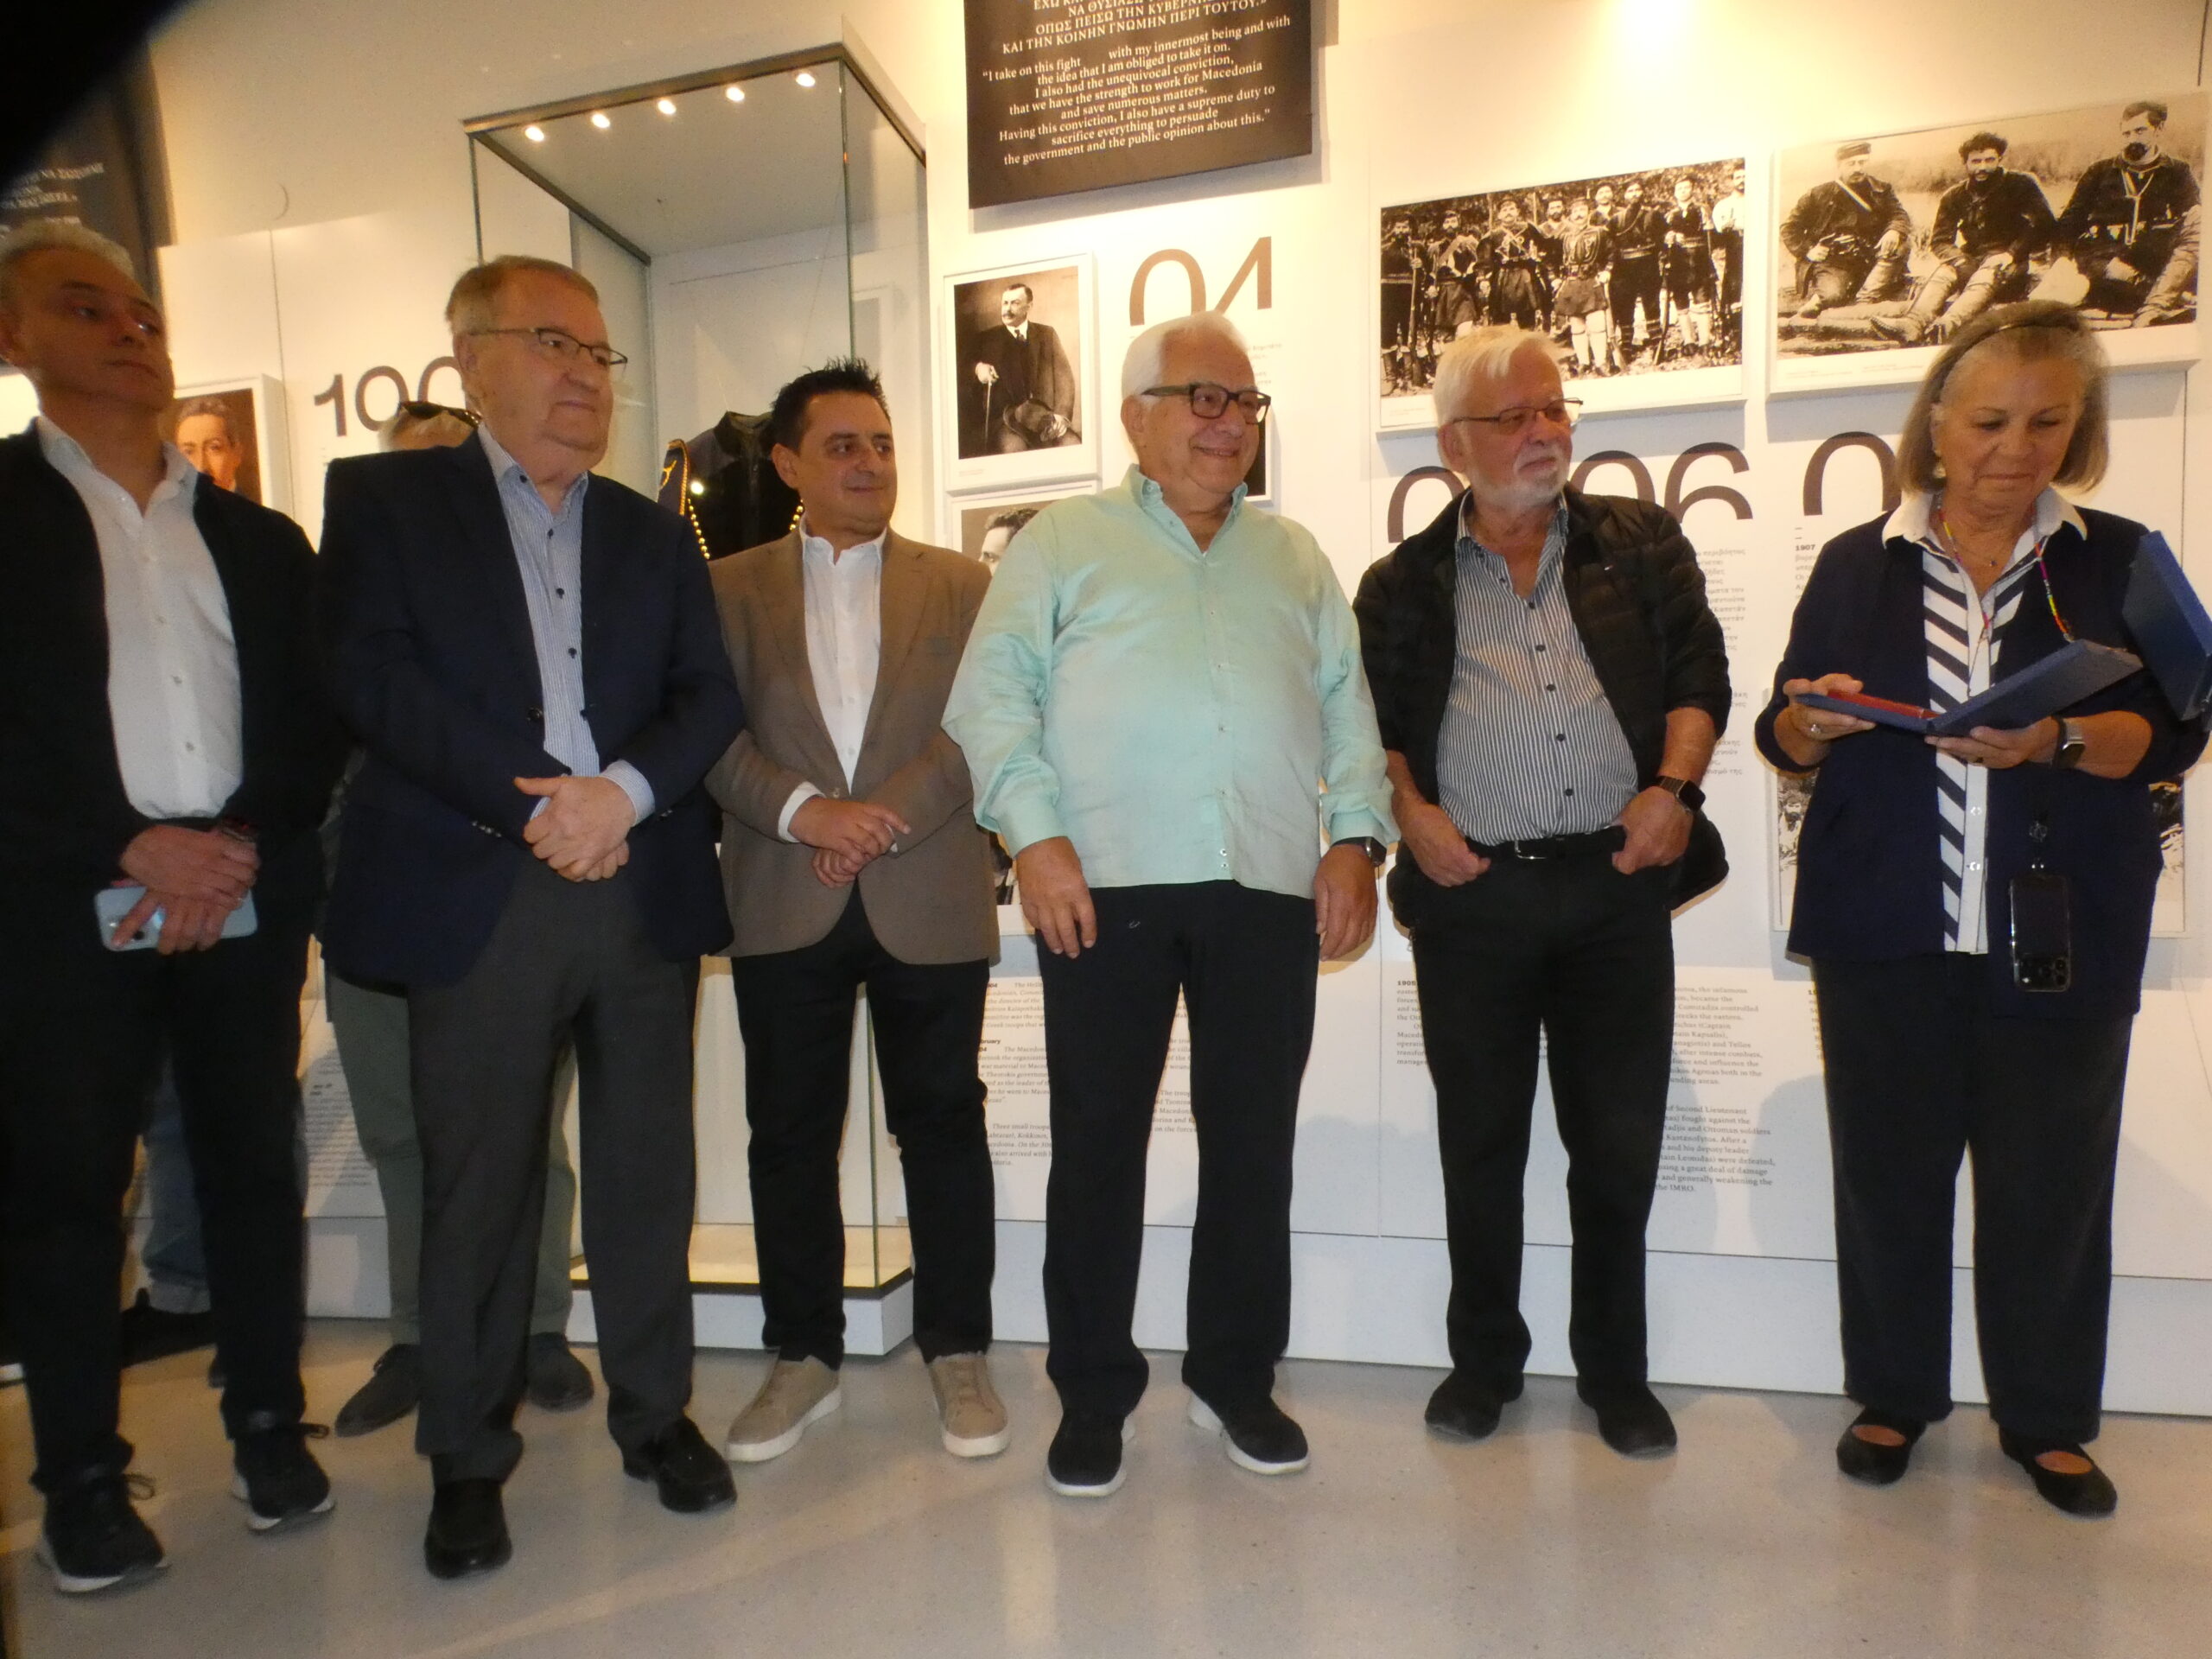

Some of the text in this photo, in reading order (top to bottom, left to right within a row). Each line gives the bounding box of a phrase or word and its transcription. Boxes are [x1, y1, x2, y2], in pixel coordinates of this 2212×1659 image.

[1003, 41, 1023, 54] ΚΑΙ
[1027, 36, 1052, 50] ΤΗΝ
[1057, 24, 1105, 46] ΚΟΙΝΗΝ
[1109, 16, 1166, 34] ΓΝΩΜΗΝ
[1170, 8, 1200, 24] ΠΕΡΙ
[1036, 20, 1071, 35] ΟΠΩΣ
[1076, 11, 1113, 29] ΠΕΙΣΩ
[1116, 6, 1147, 19] ΤΗΝ
[995, 67, 1017, 80] take
[1020, 66, 1032, 76] on
[1034, 61, 1054, 73] this
[1057, 56, 1081, 72] fight
[1109, 44, 1132, 60] with
[1135, 45, 1152, 57] my
[1154, 32, 1209, 52] innermost
[1212, 26, 1242, 40] being
[1244, 20, 1263, 35] and
[1267, 15, 1290, 29] with
[1038, 43, 1230, 86] the idea that I am obliged to take it on.
[1009, 60, 1262, 116] that we have the strength to work for Macedonia
[1035, 54, 1234, 99] I also had the unequivocal conviction,
[1000, 86, 1275, 142] Having this conviction, I also have a supreme duty to
[1061, 86, 1207, 119] and save numerous matters.
[1004, 153, 1020, 166] the
[1023, 145, 1084, 165] government
[1087, 139, 1106, 152] and
[1109, 137, 1125, 148] the
[1128, 130, 1160, 147] public
[1164, 124, 1205, 141] opinion
[1207, 119, 1237, 131] about
[1052, 107, 1218, 146] sacrifice everything to persuade
